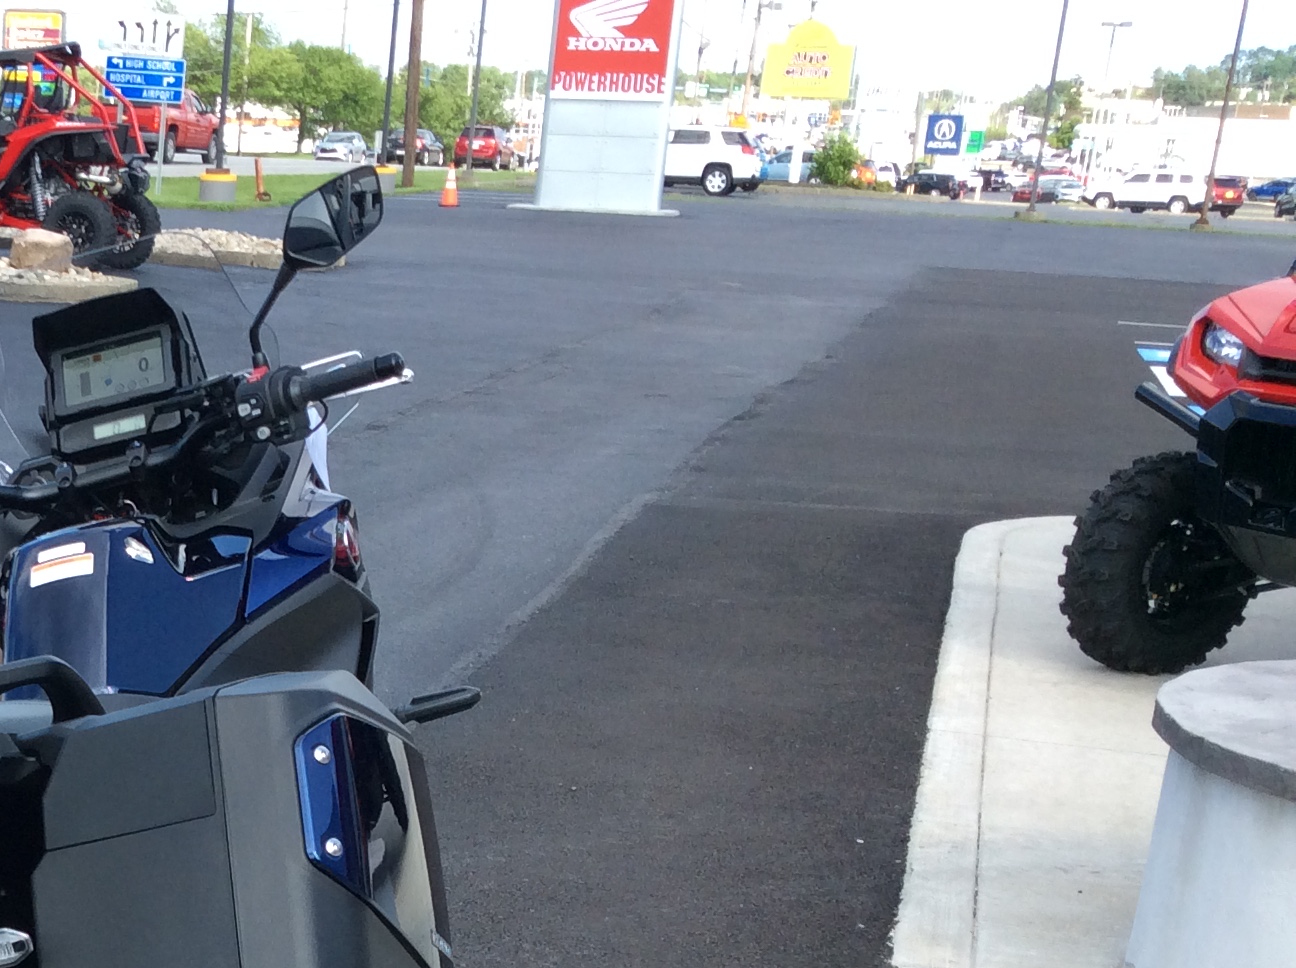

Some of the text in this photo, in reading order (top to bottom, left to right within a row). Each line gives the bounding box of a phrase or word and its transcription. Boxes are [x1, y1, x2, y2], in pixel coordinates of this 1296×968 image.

[566, 36, 660, 52] HONDA
[125, 59, 177, 71] HIGH SCHOOL
[109, 73, 146, 84] HOSPITAL
[550, 71, 666, 94] POWERHOUSE
[142, 90, 175, 100] AIRPORT
[926, 140, 957, 149] ACURA
